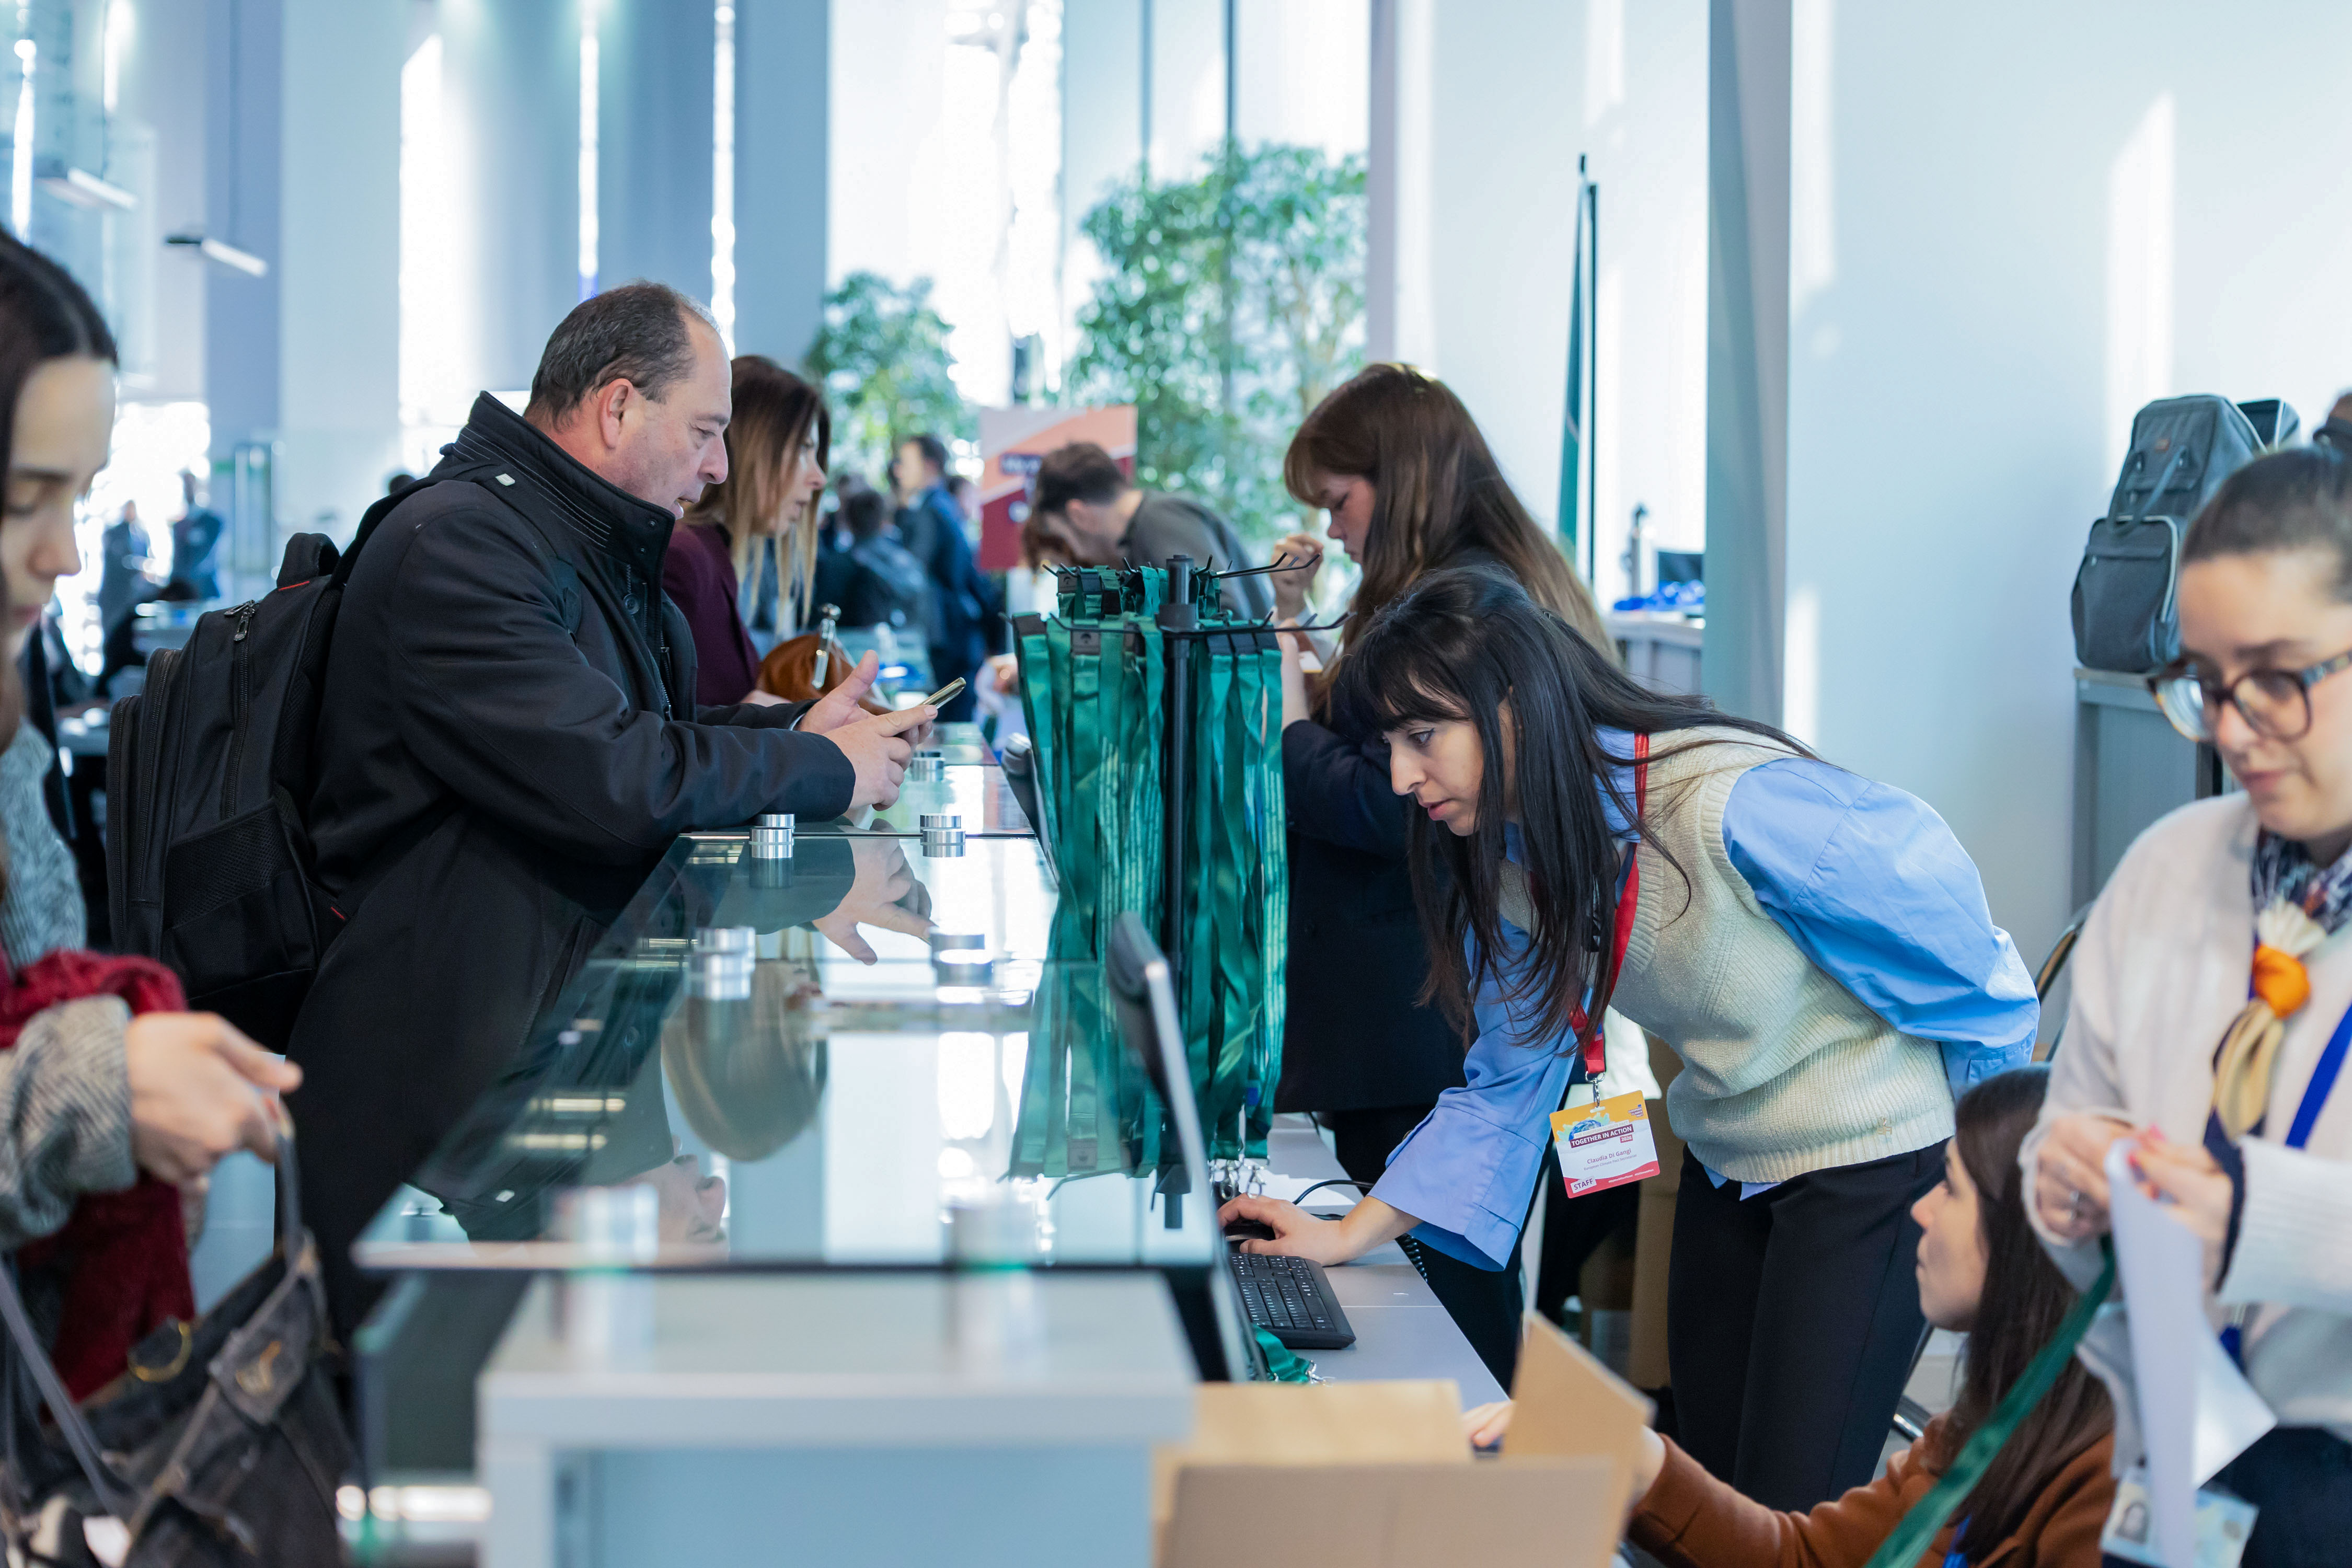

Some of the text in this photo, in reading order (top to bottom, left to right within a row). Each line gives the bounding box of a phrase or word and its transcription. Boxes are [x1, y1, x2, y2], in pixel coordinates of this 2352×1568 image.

[1571, 1134, 1602, 1147] TOGETHER
[1609, 1126, 1632, 1136] ACTION
[1587, 1155, 1608, 1165] Claudia
[1615, 1148, 1632, 1158] Gangi
[1574, 1178, 1593, 1190] STAFF
